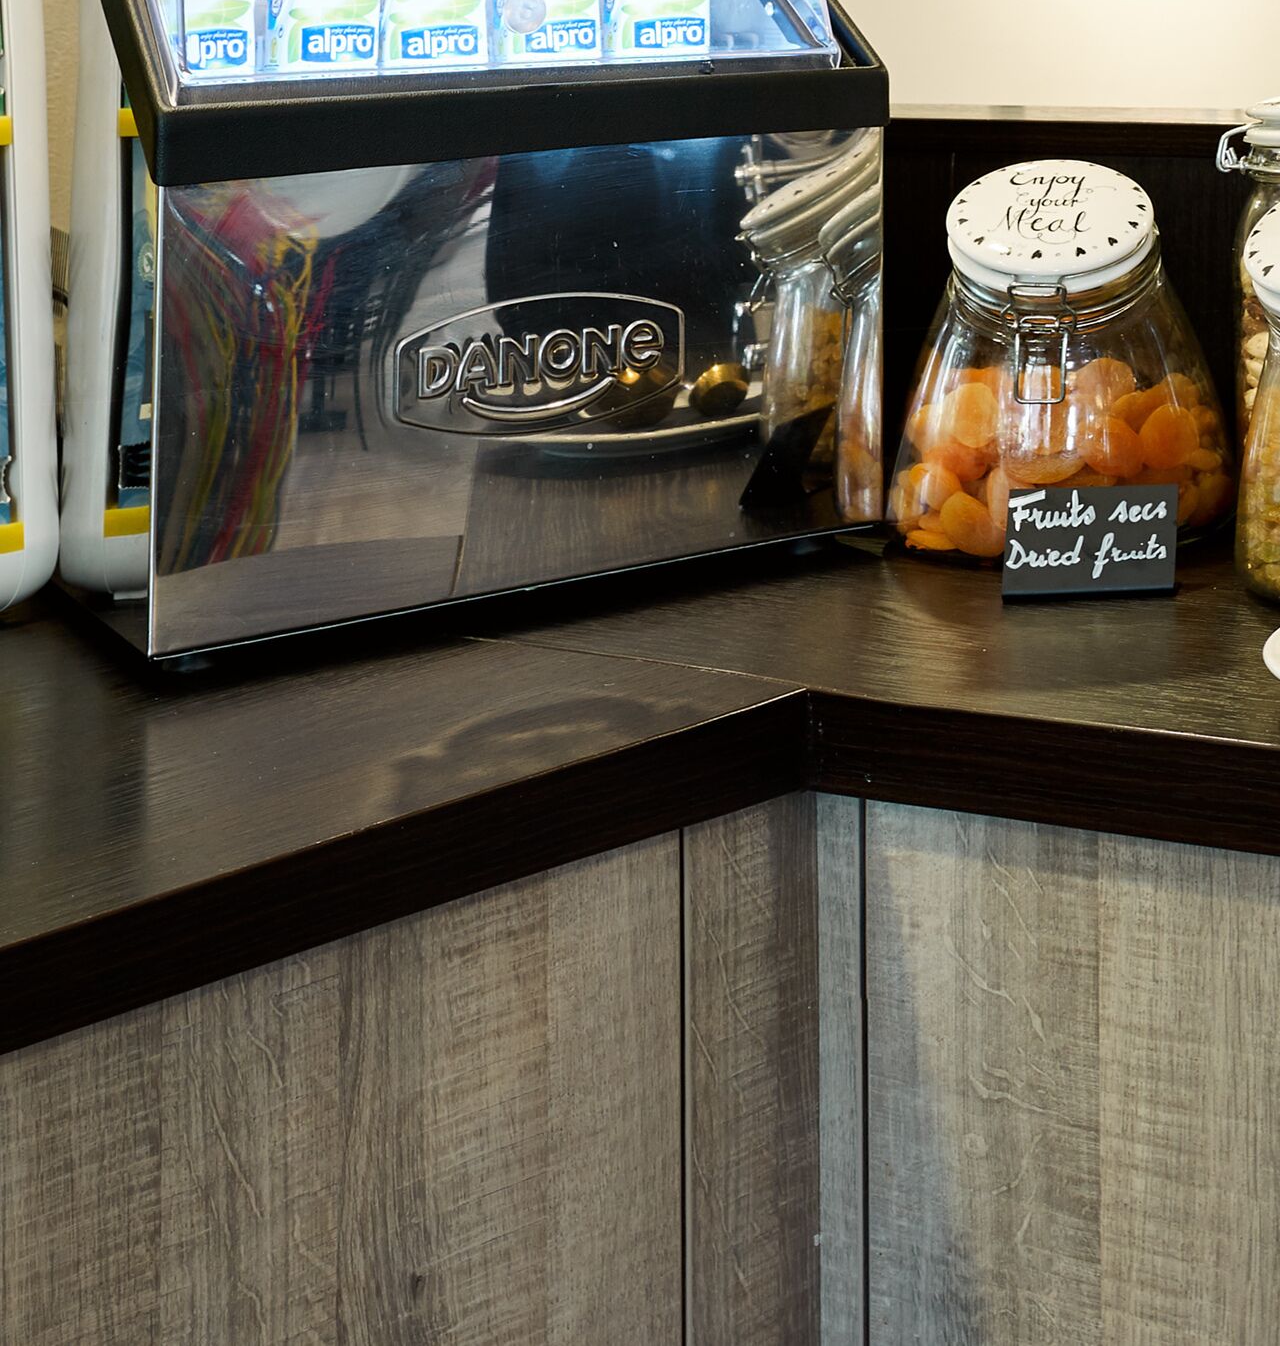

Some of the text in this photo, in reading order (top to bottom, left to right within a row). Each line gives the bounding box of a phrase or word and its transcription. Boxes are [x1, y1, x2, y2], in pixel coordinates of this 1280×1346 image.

[186, 33, 246, 68] lpro
[307, 27, 373, 61] alpro
[407, 29, 476, 60] alpro
[530, 24, 594, 52] alpro
[640, 21, 704, 48] alpro
[1009, 172, 1086, 198] Enjoy
[992, 205, 1092, 233] Meal
[417, 319, 665, 399] DANONE
[1008, 489, 1168, 532] Fruits secs
[1005, 532, 1167, 580] Dried fruits
